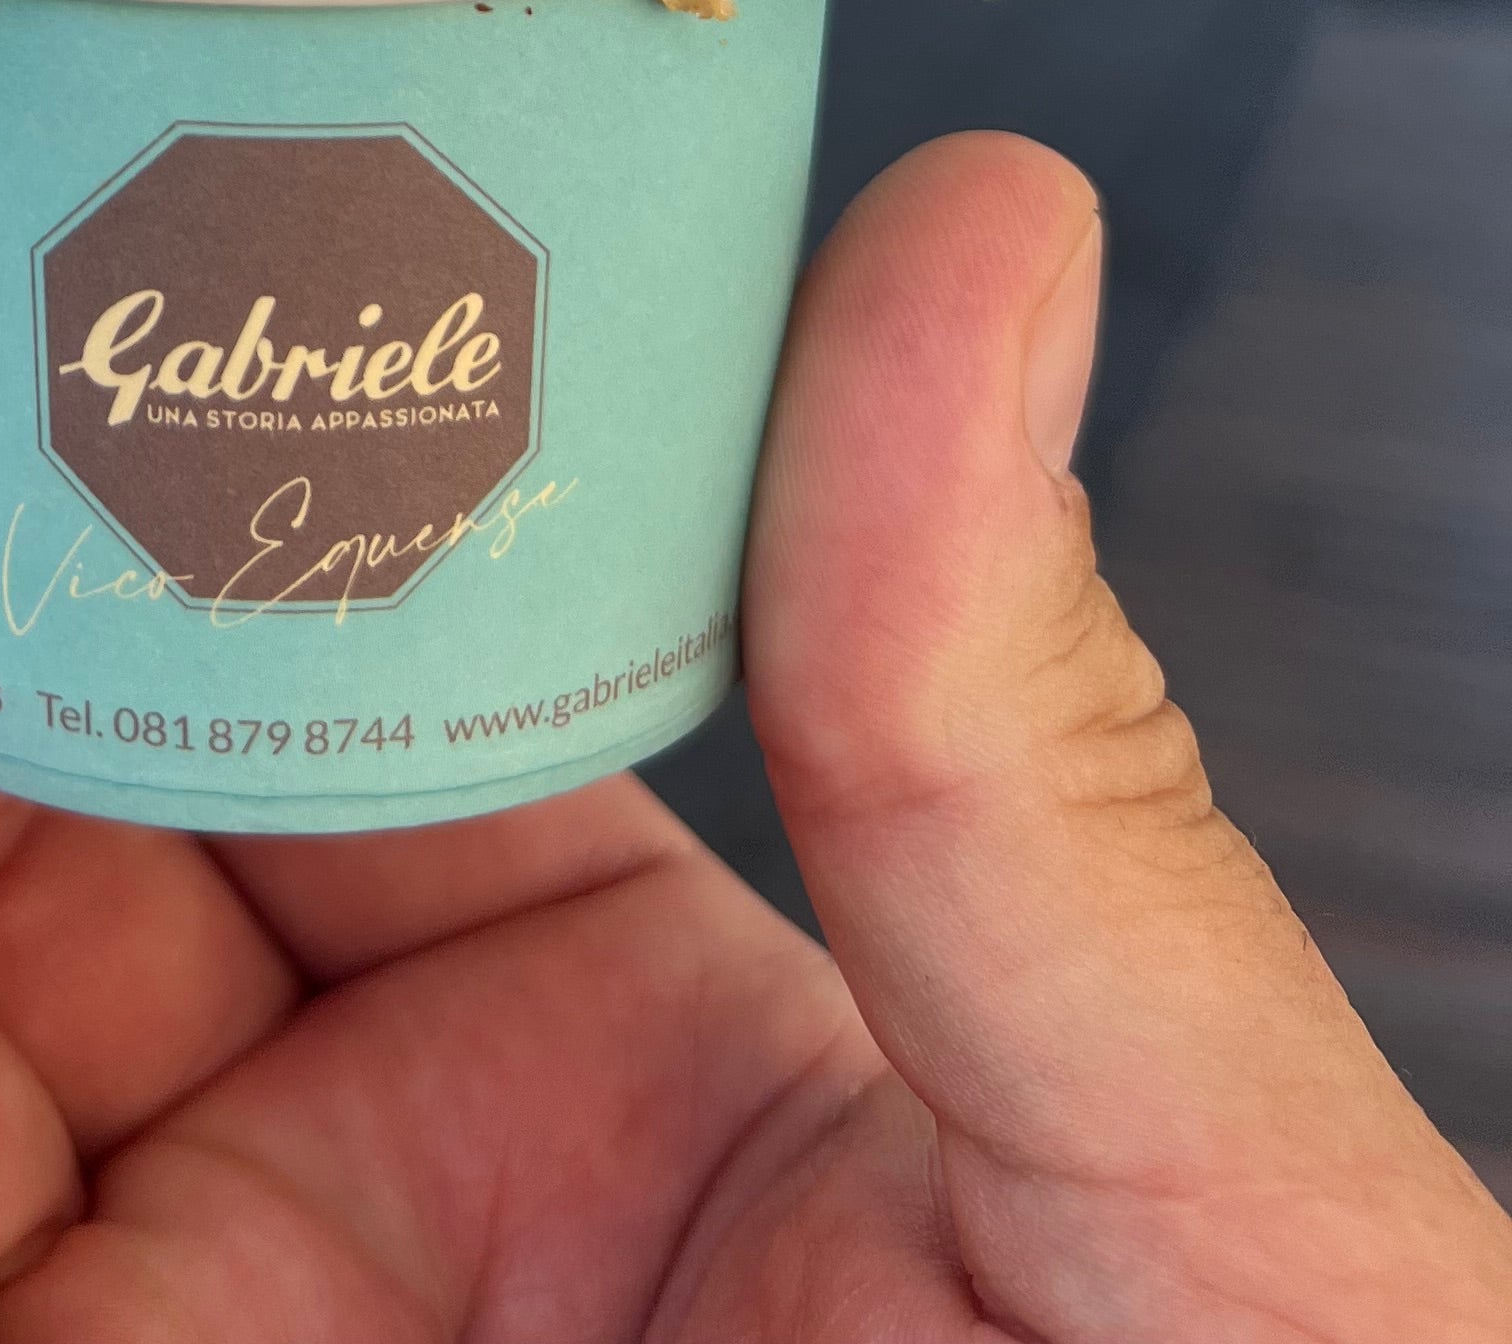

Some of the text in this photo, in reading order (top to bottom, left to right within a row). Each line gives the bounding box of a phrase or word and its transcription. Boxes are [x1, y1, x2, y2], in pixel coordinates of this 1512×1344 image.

[59, 289, 502, 427] Gabriele
[146, 399, 501, 432] UNA STORIA APPASSIONATA
[2, 476, 579, 636] Vico Equense
[35, 689, 104, 739] Tel.
[112, 706, 196, 752] 081
[207, 717, 293, 756] 879
[303, 713, 416, 756] 8744
